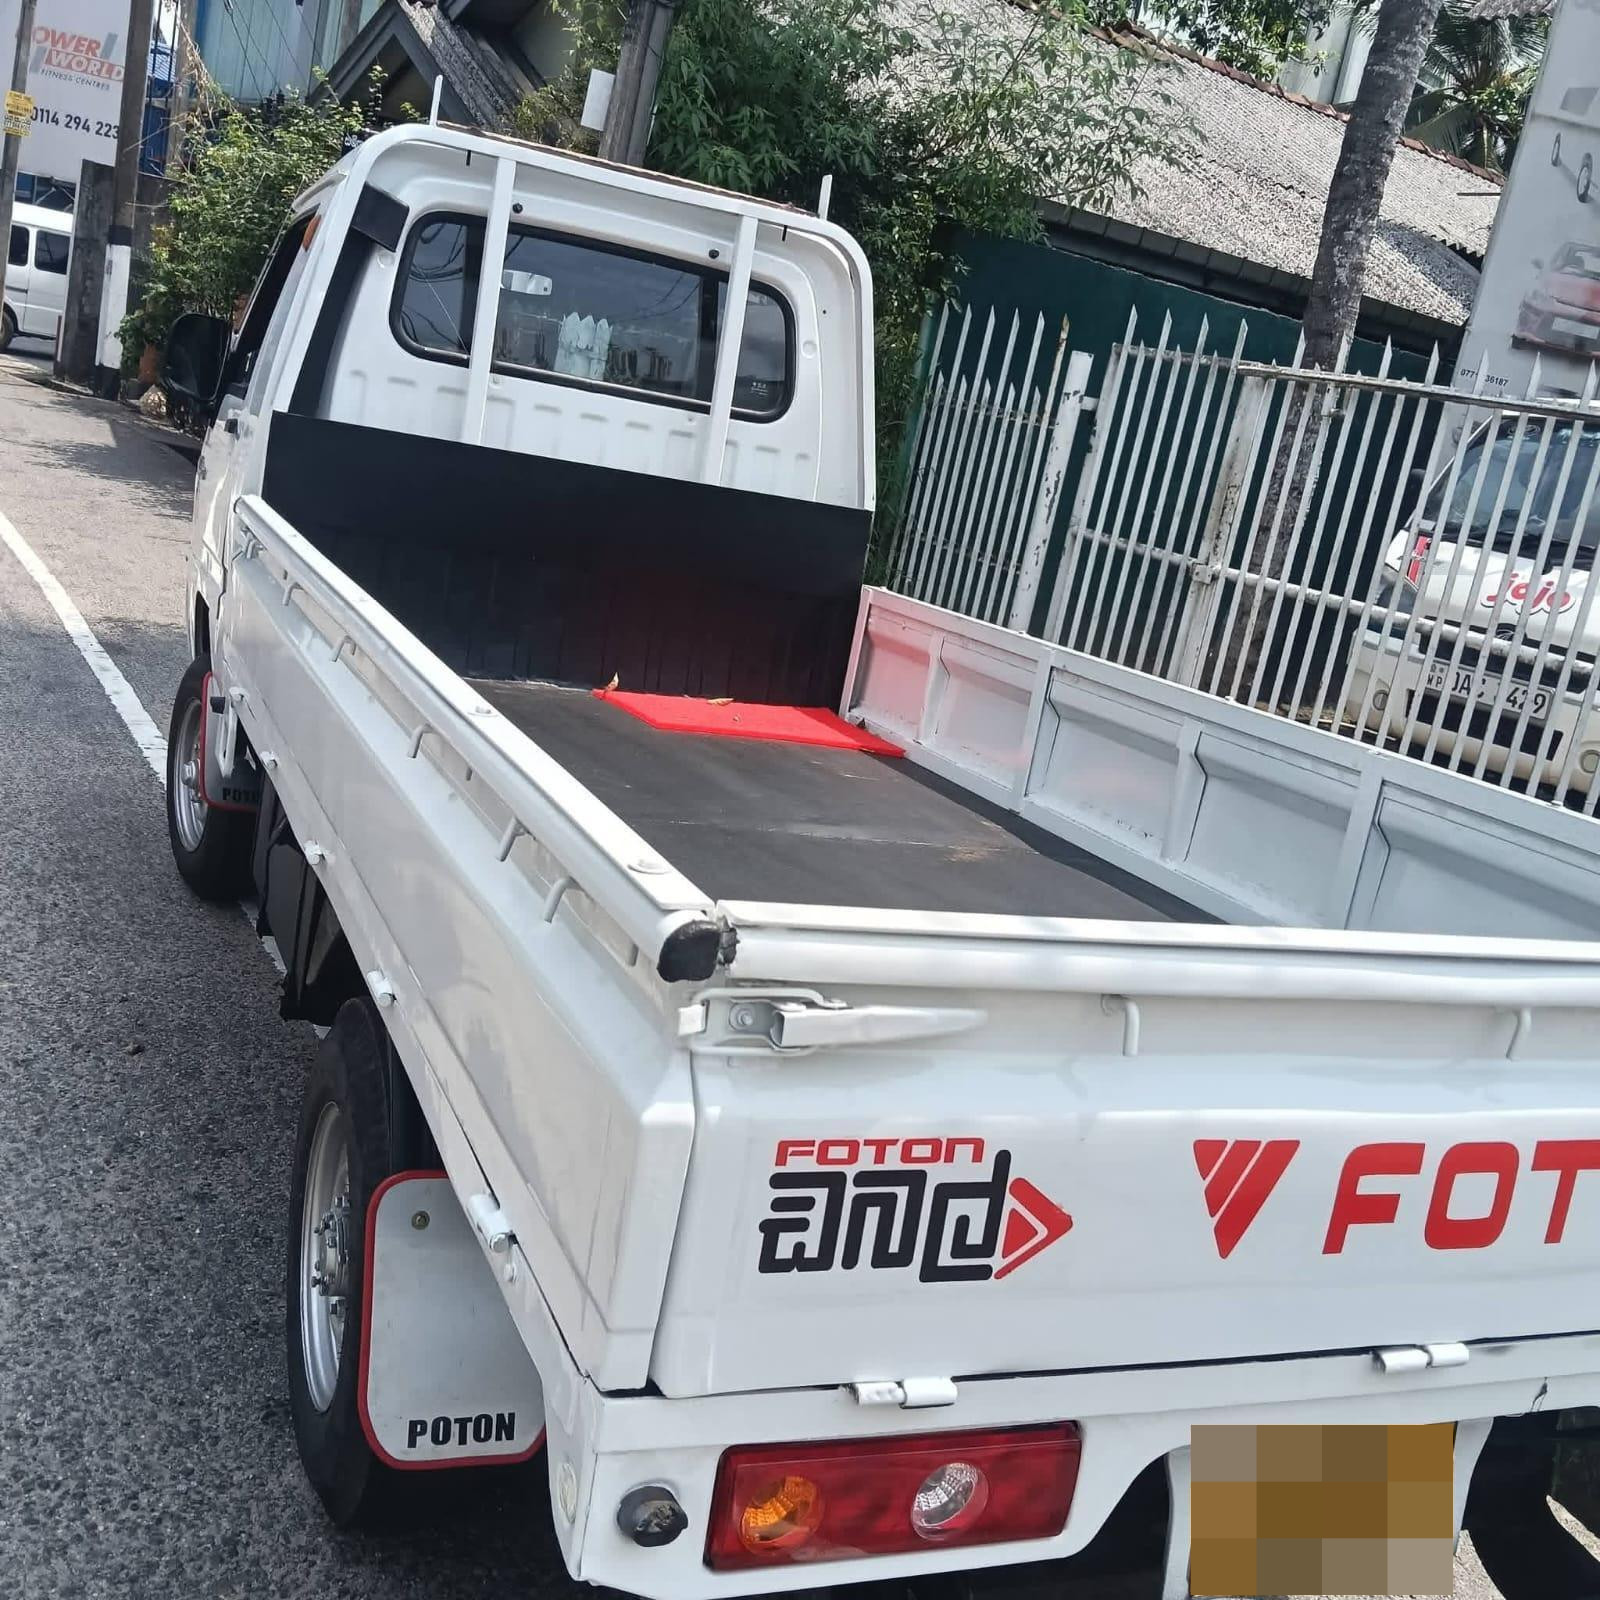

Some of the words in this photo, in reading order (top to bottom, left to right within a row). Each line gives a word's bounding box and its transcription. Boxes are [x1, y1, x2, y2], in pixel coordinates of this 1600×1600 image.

[16, 25, 101, 57] OWER
[40, 68, 73, 83] FITNESS
[51, 50, 125, 82] WORLD
[30, 106, 60, 126] 0114
[64, 114, 91, 133] 294
[775, 1137, 985, 1167] FOTON
[407, 1412, 516, 1449] POTON
